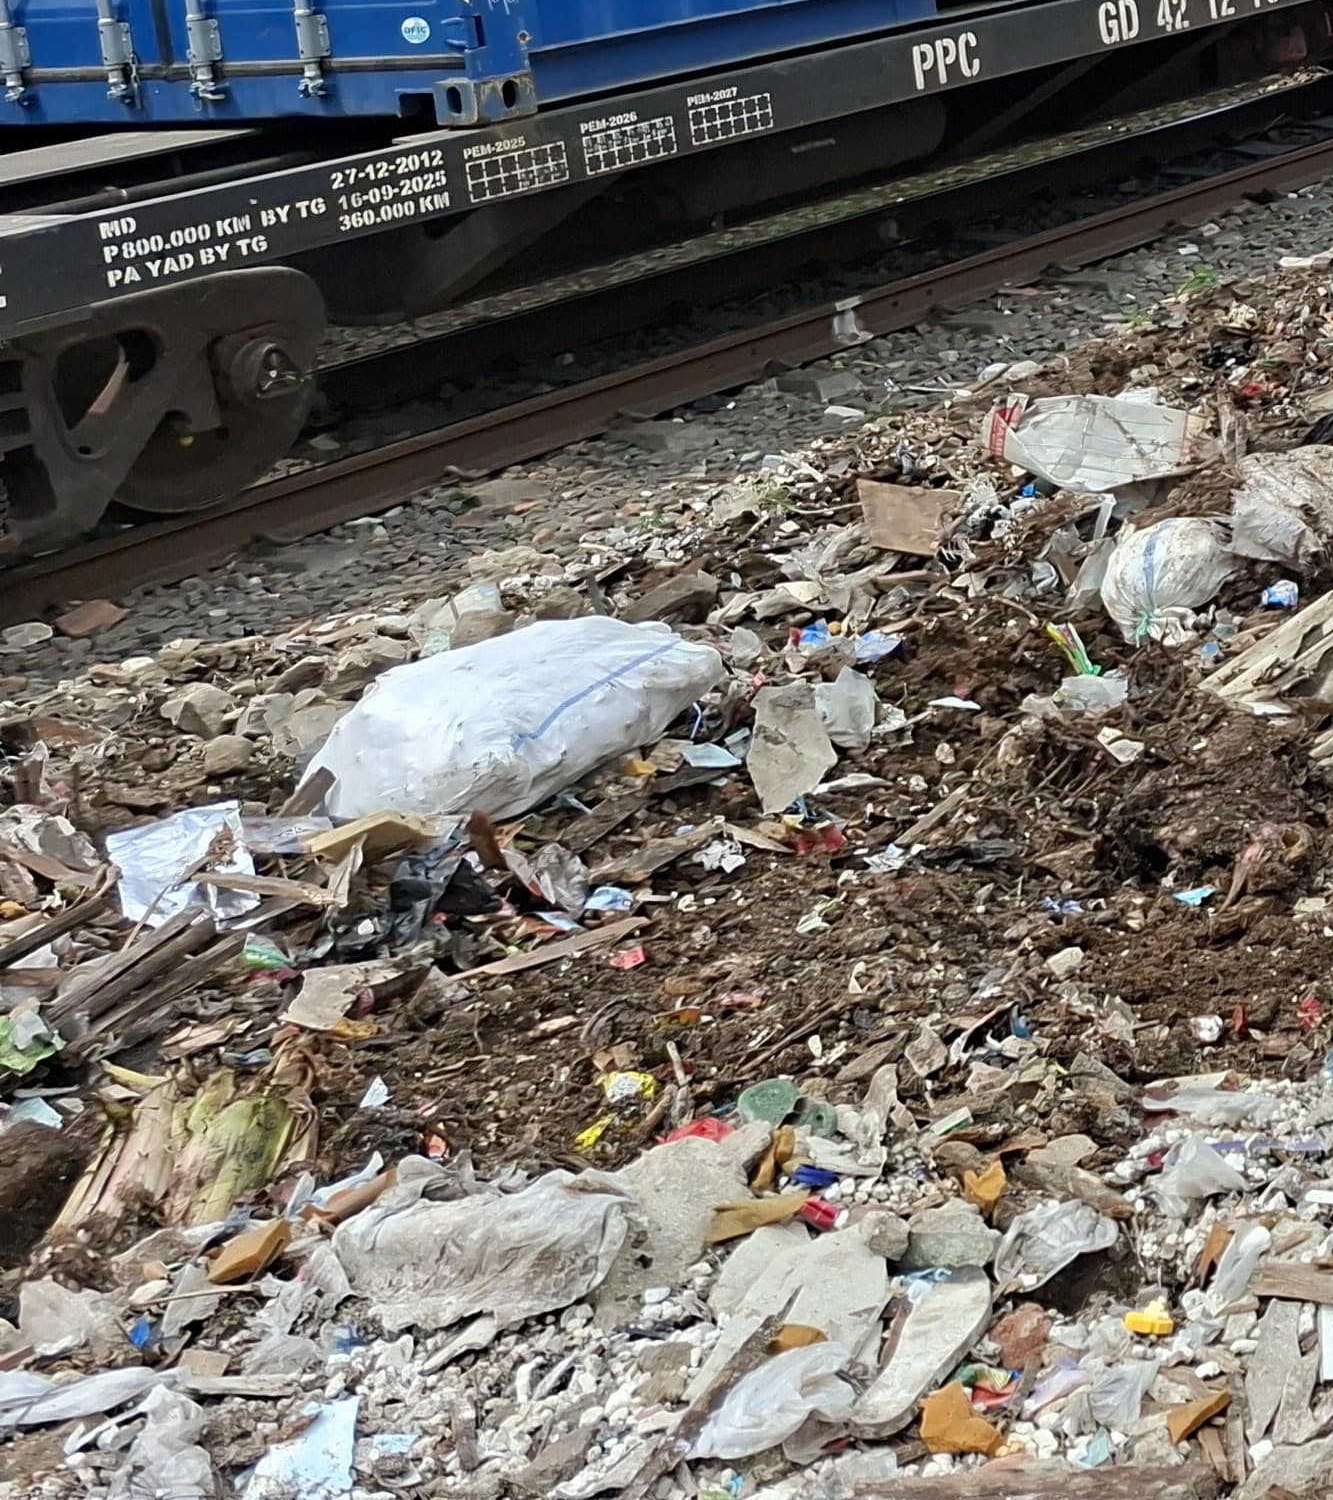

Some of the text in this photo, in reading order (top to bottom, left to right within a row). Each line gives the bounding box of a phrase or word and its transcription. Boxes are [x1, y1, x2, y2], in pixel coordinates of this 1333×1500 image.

[912, 31, 981, 91] PPC
[463, 86, 739, 160] PEM-2025 PEM-2026 PEM-2027
[99, 148, 445, 241] MD 27-12-2012
[216, 212, 252, 238] KM
[260, 203, 292, 227] BY
[295, 195, 328, 219] TG
[337, 169, 448, 211] 16-09-2025
[107, 191, 450, 288] PA YAD BY TG 360.000 KM
